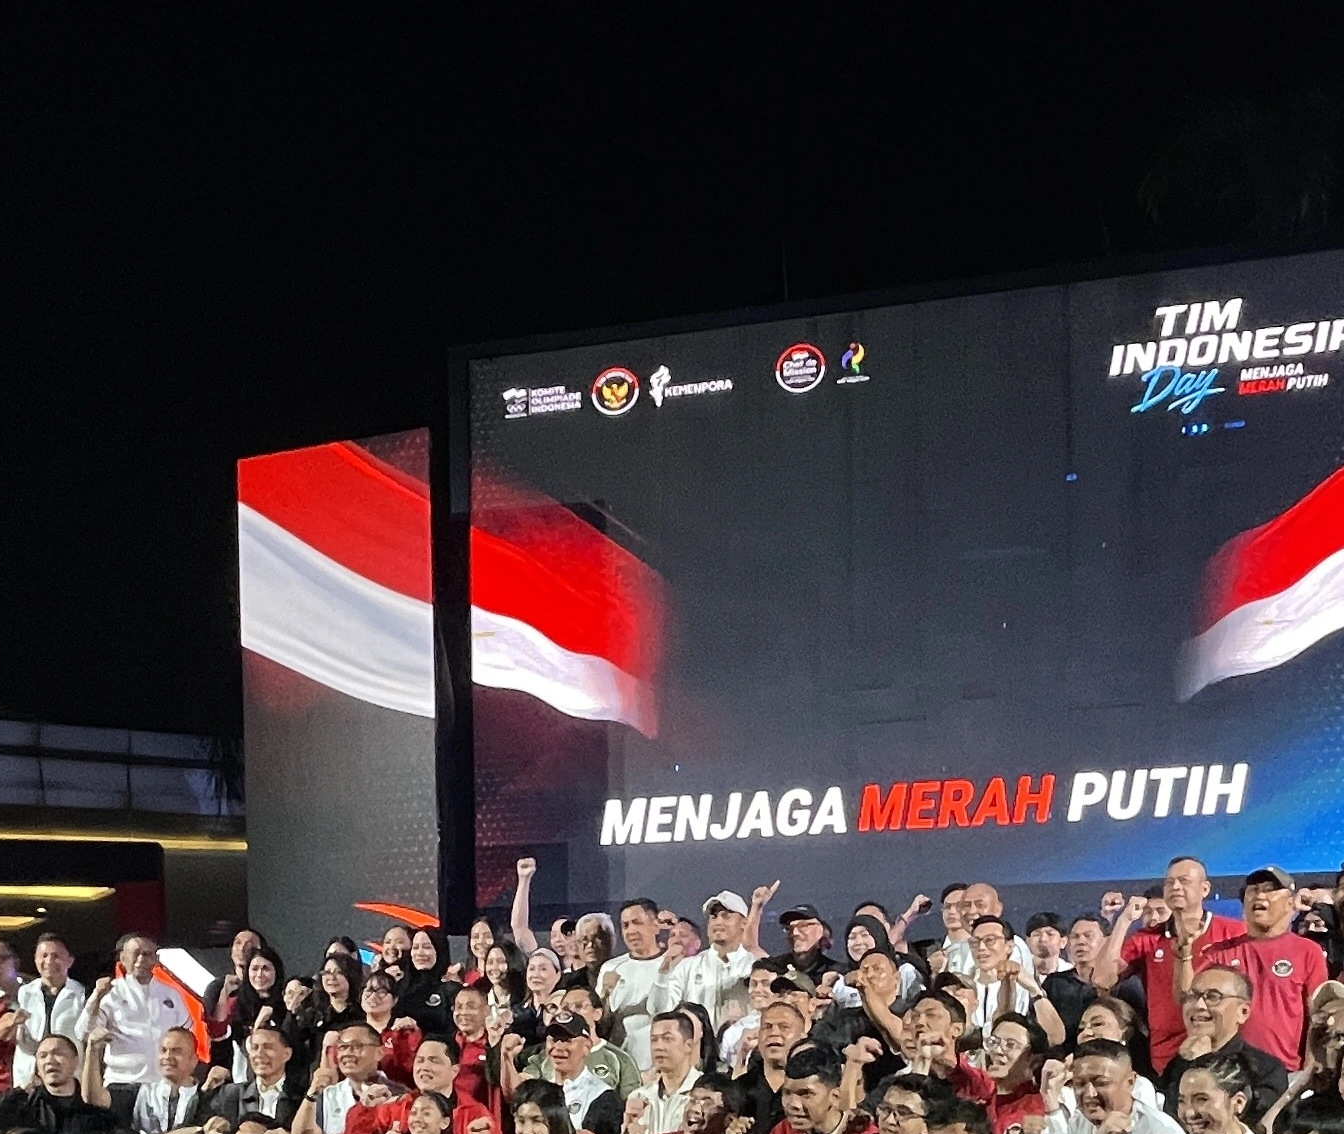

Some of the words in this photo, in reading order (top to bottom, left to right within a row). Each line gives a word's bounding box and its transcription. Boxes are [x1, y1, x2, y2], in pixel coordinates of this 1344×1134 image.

[1155, 297, 1244, 337] TIM
[1240, 362, 1305, 382] MENJAGA
[1286, 373, 1330, 391] PUTIH
[664, 378, 734, 398] KEMENPORA
[1130, 365, 1226, 415] Day
[599, 786, 848, 846] MENJAGA
[858, 774, 1056, 833] MERAH
[1067, 762, 1250, 823] PUTIH
